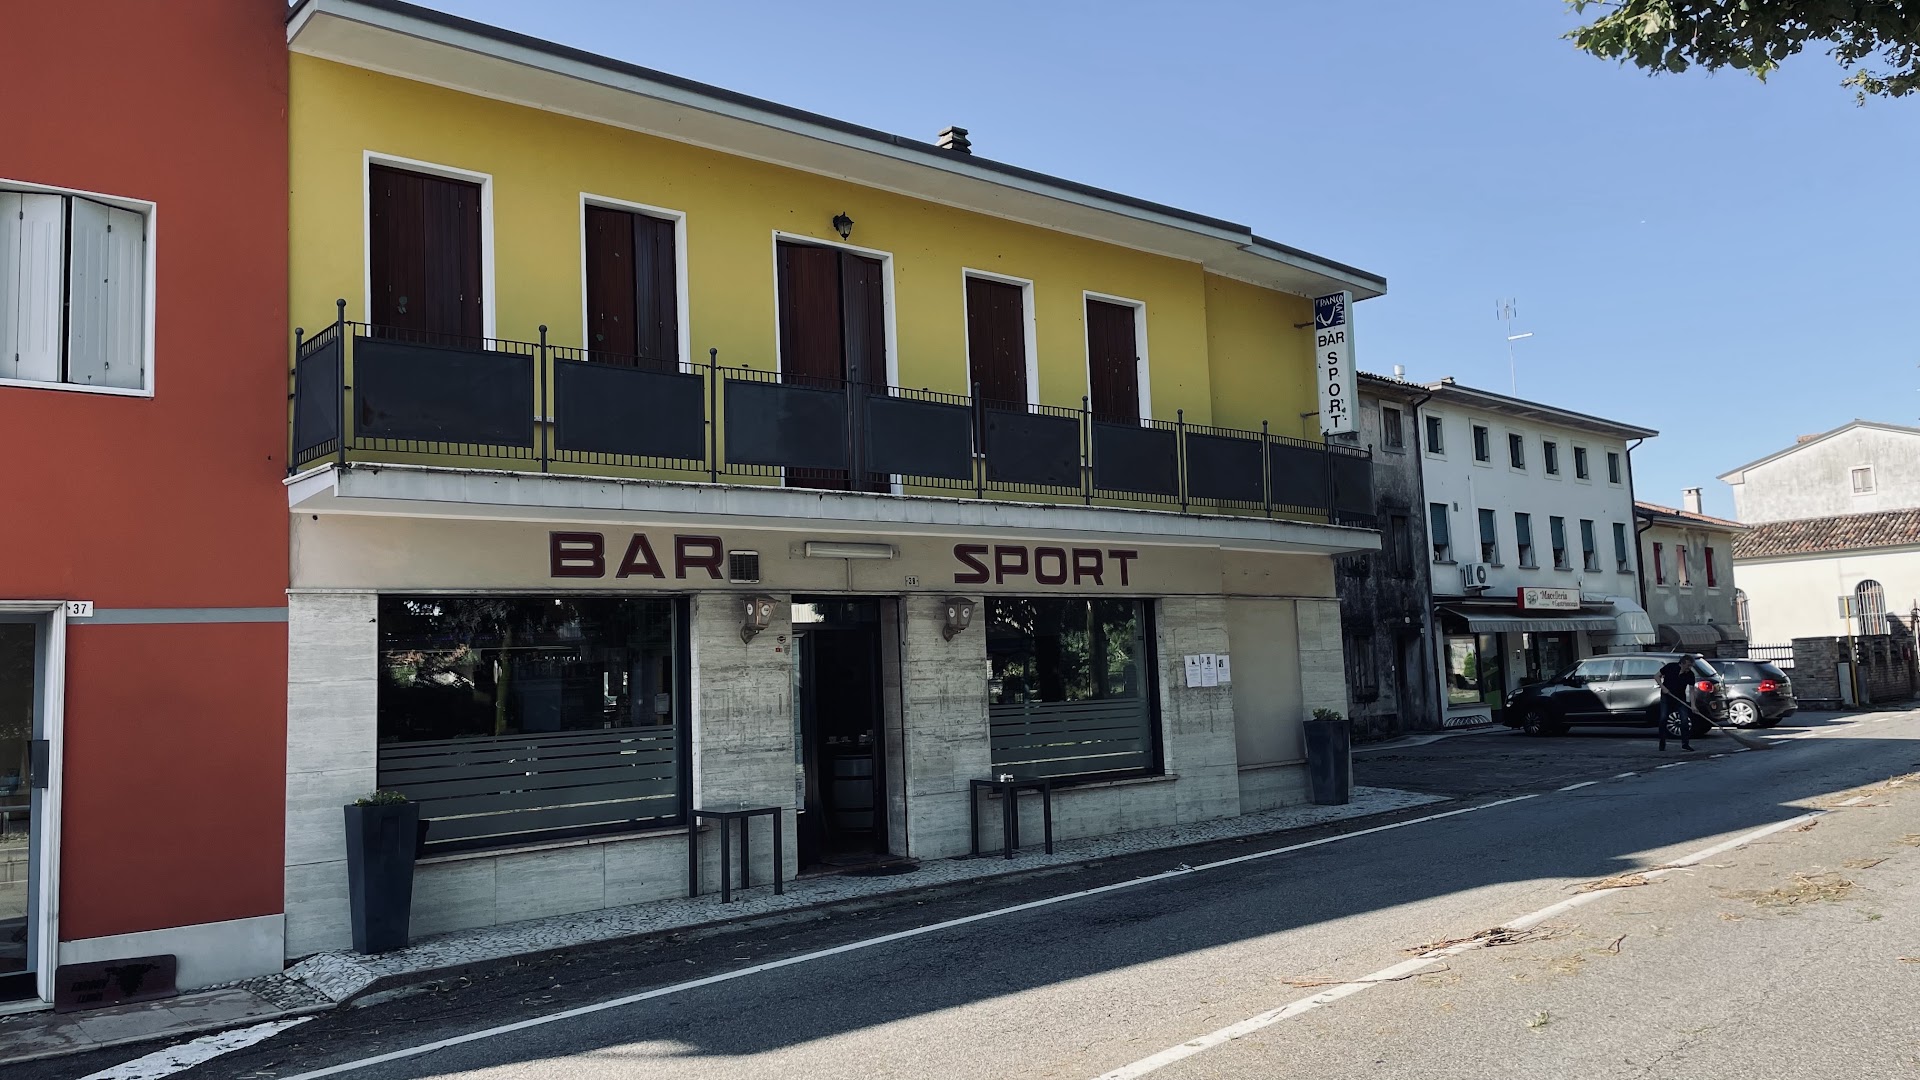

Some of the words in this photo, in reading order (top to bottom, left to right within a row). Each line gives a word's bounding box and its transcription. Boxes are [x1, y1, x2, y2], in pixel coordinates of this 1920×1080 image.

[1318, 332, 1344, 347] BAR
[1327, 352, 1341, 428] SPORT
[549, 531, 724, 579] BAR
[953, 544, 1138, 586] SPORT
[73, 604, 87, 615] 37
